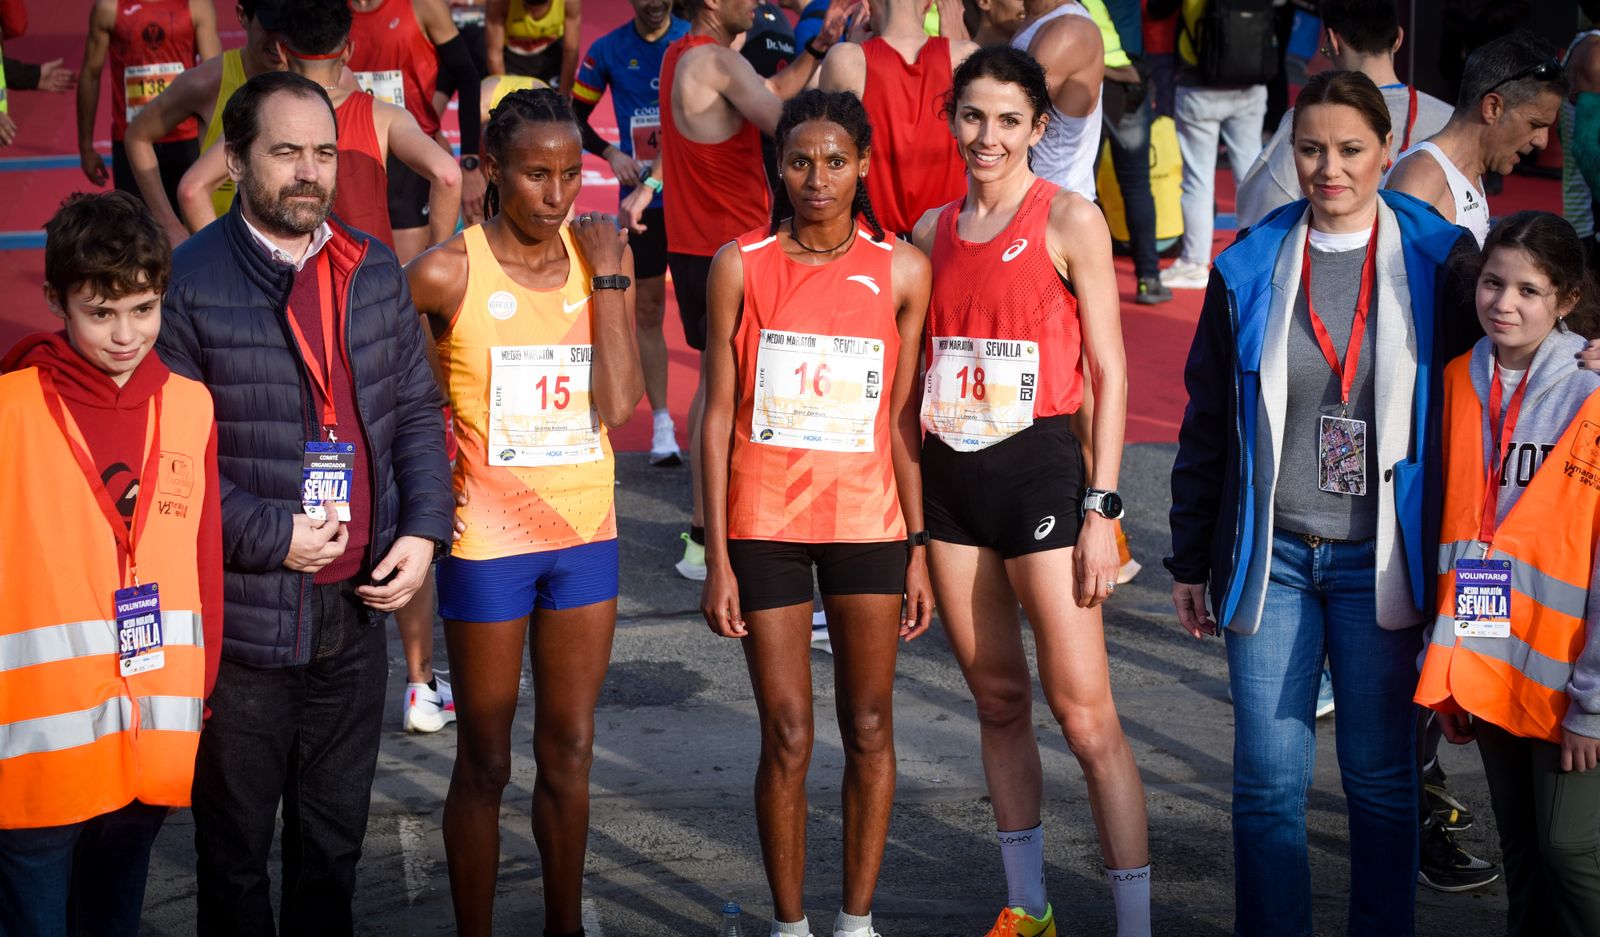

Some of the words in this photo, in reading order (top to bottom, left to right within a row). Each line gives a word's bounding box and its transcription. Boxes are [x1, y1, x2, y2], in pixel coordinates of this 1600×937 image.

[139, 79, 165, 95] 138
[647, 130, 662, 149] 4
[766, 333, 784, 345] MEDIO
[786, 335, 816, 348] MARATÓN
[833, 338, 868, 355] SEVILLA
[949, 339, 974, 352] MARATÓN
[985, 341, 1021, 357] SEVILLA
[523, 348, 554, 360] MARATÓN
[570, 347, 593, 363] SEVIL
[794, 361, 831, 397] 16
[956, 365, 986, 401] 18
[535, 375, 571, 410] 15
[310, 471, 324, 480] MEDIO
[324, 470, 345, 480] MARATÓN
[304, 479, 348, 500] SEVILLA
[1459, 572, 1508, 582] VOLUNTARI@
[1463, 586, 1479, 595] MEDIO
[1479, 586, 1502, 596] MARATÓN
[118, 597, 158, 613] VOLUNTARI@
[1457, 594, 1507, 616] SEVILLA
[123, 618, 136, 629] MEDIO
[136, 613, 155, 627] MARATÓN
[120, 623, 161, 652] SEVILLA
